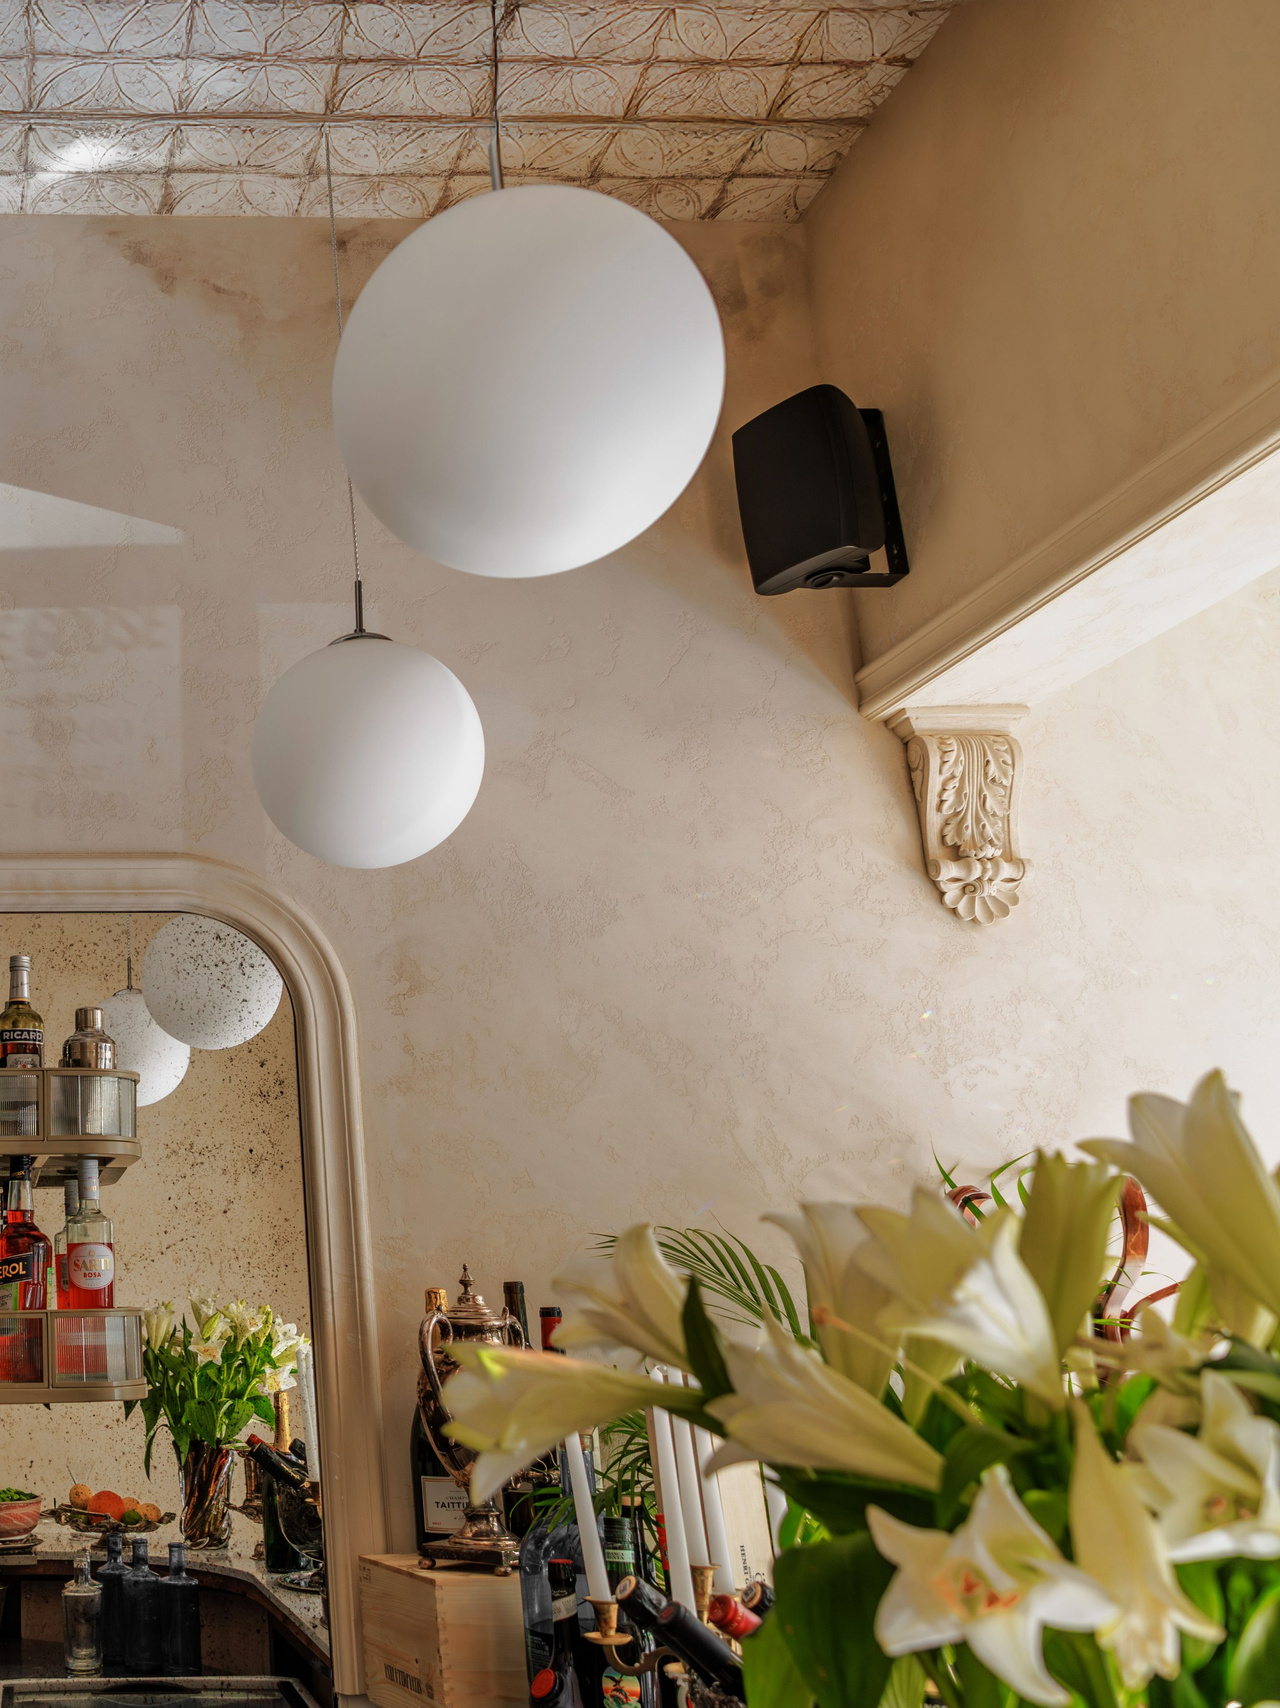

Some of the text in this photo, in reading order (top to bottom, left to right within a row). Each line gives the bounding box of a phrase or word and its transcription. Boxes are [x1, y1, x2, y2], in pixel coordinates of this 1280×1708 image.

[2, 1031, 43, 1040] RICARD
[73, 1258, 110, 1271] SARTI
[740, 1545, 749, 1575] HENRI
